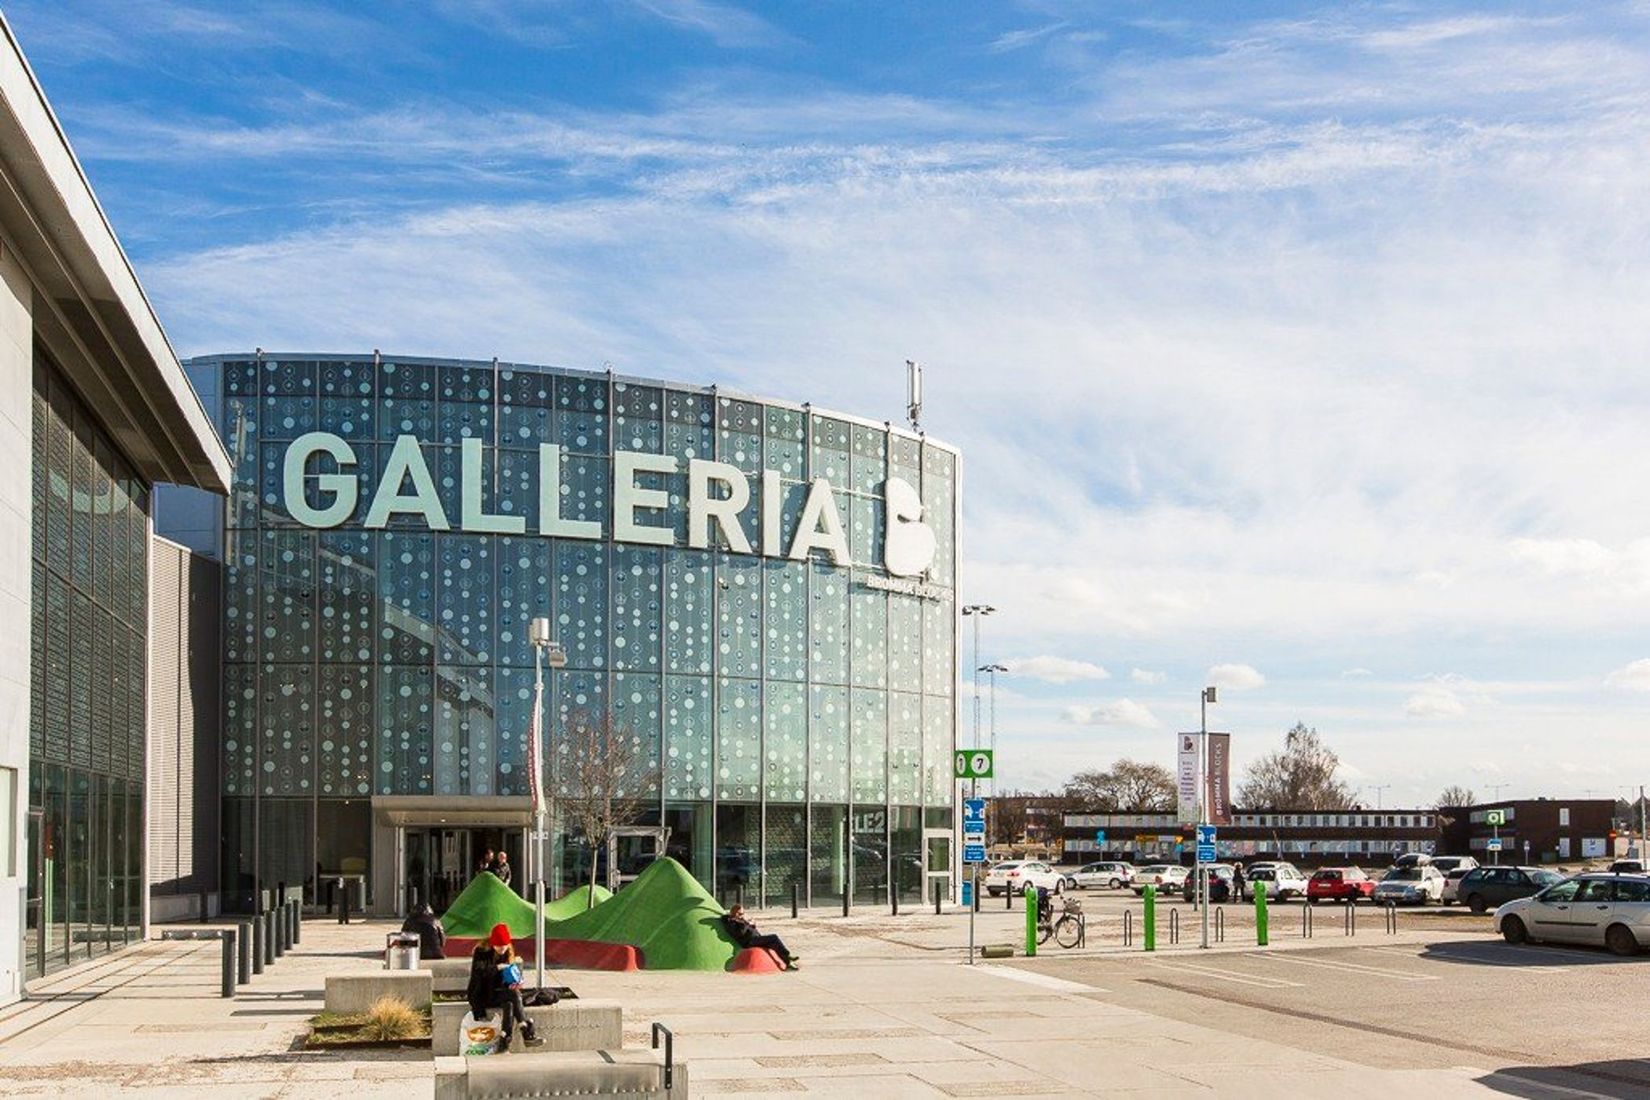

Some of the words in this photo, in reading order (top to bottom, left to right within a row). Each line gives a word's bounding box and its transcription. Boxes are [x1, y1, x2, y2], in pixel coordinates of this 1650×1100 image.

[283, 431, 851, 567] GALLERIA
[867, 574, 915, 593] BROMMA
[976, 758, 984, 770] 7
[1214, 777, 1223, 816] BROMMA
[855, 811, 885, 834] LE2
